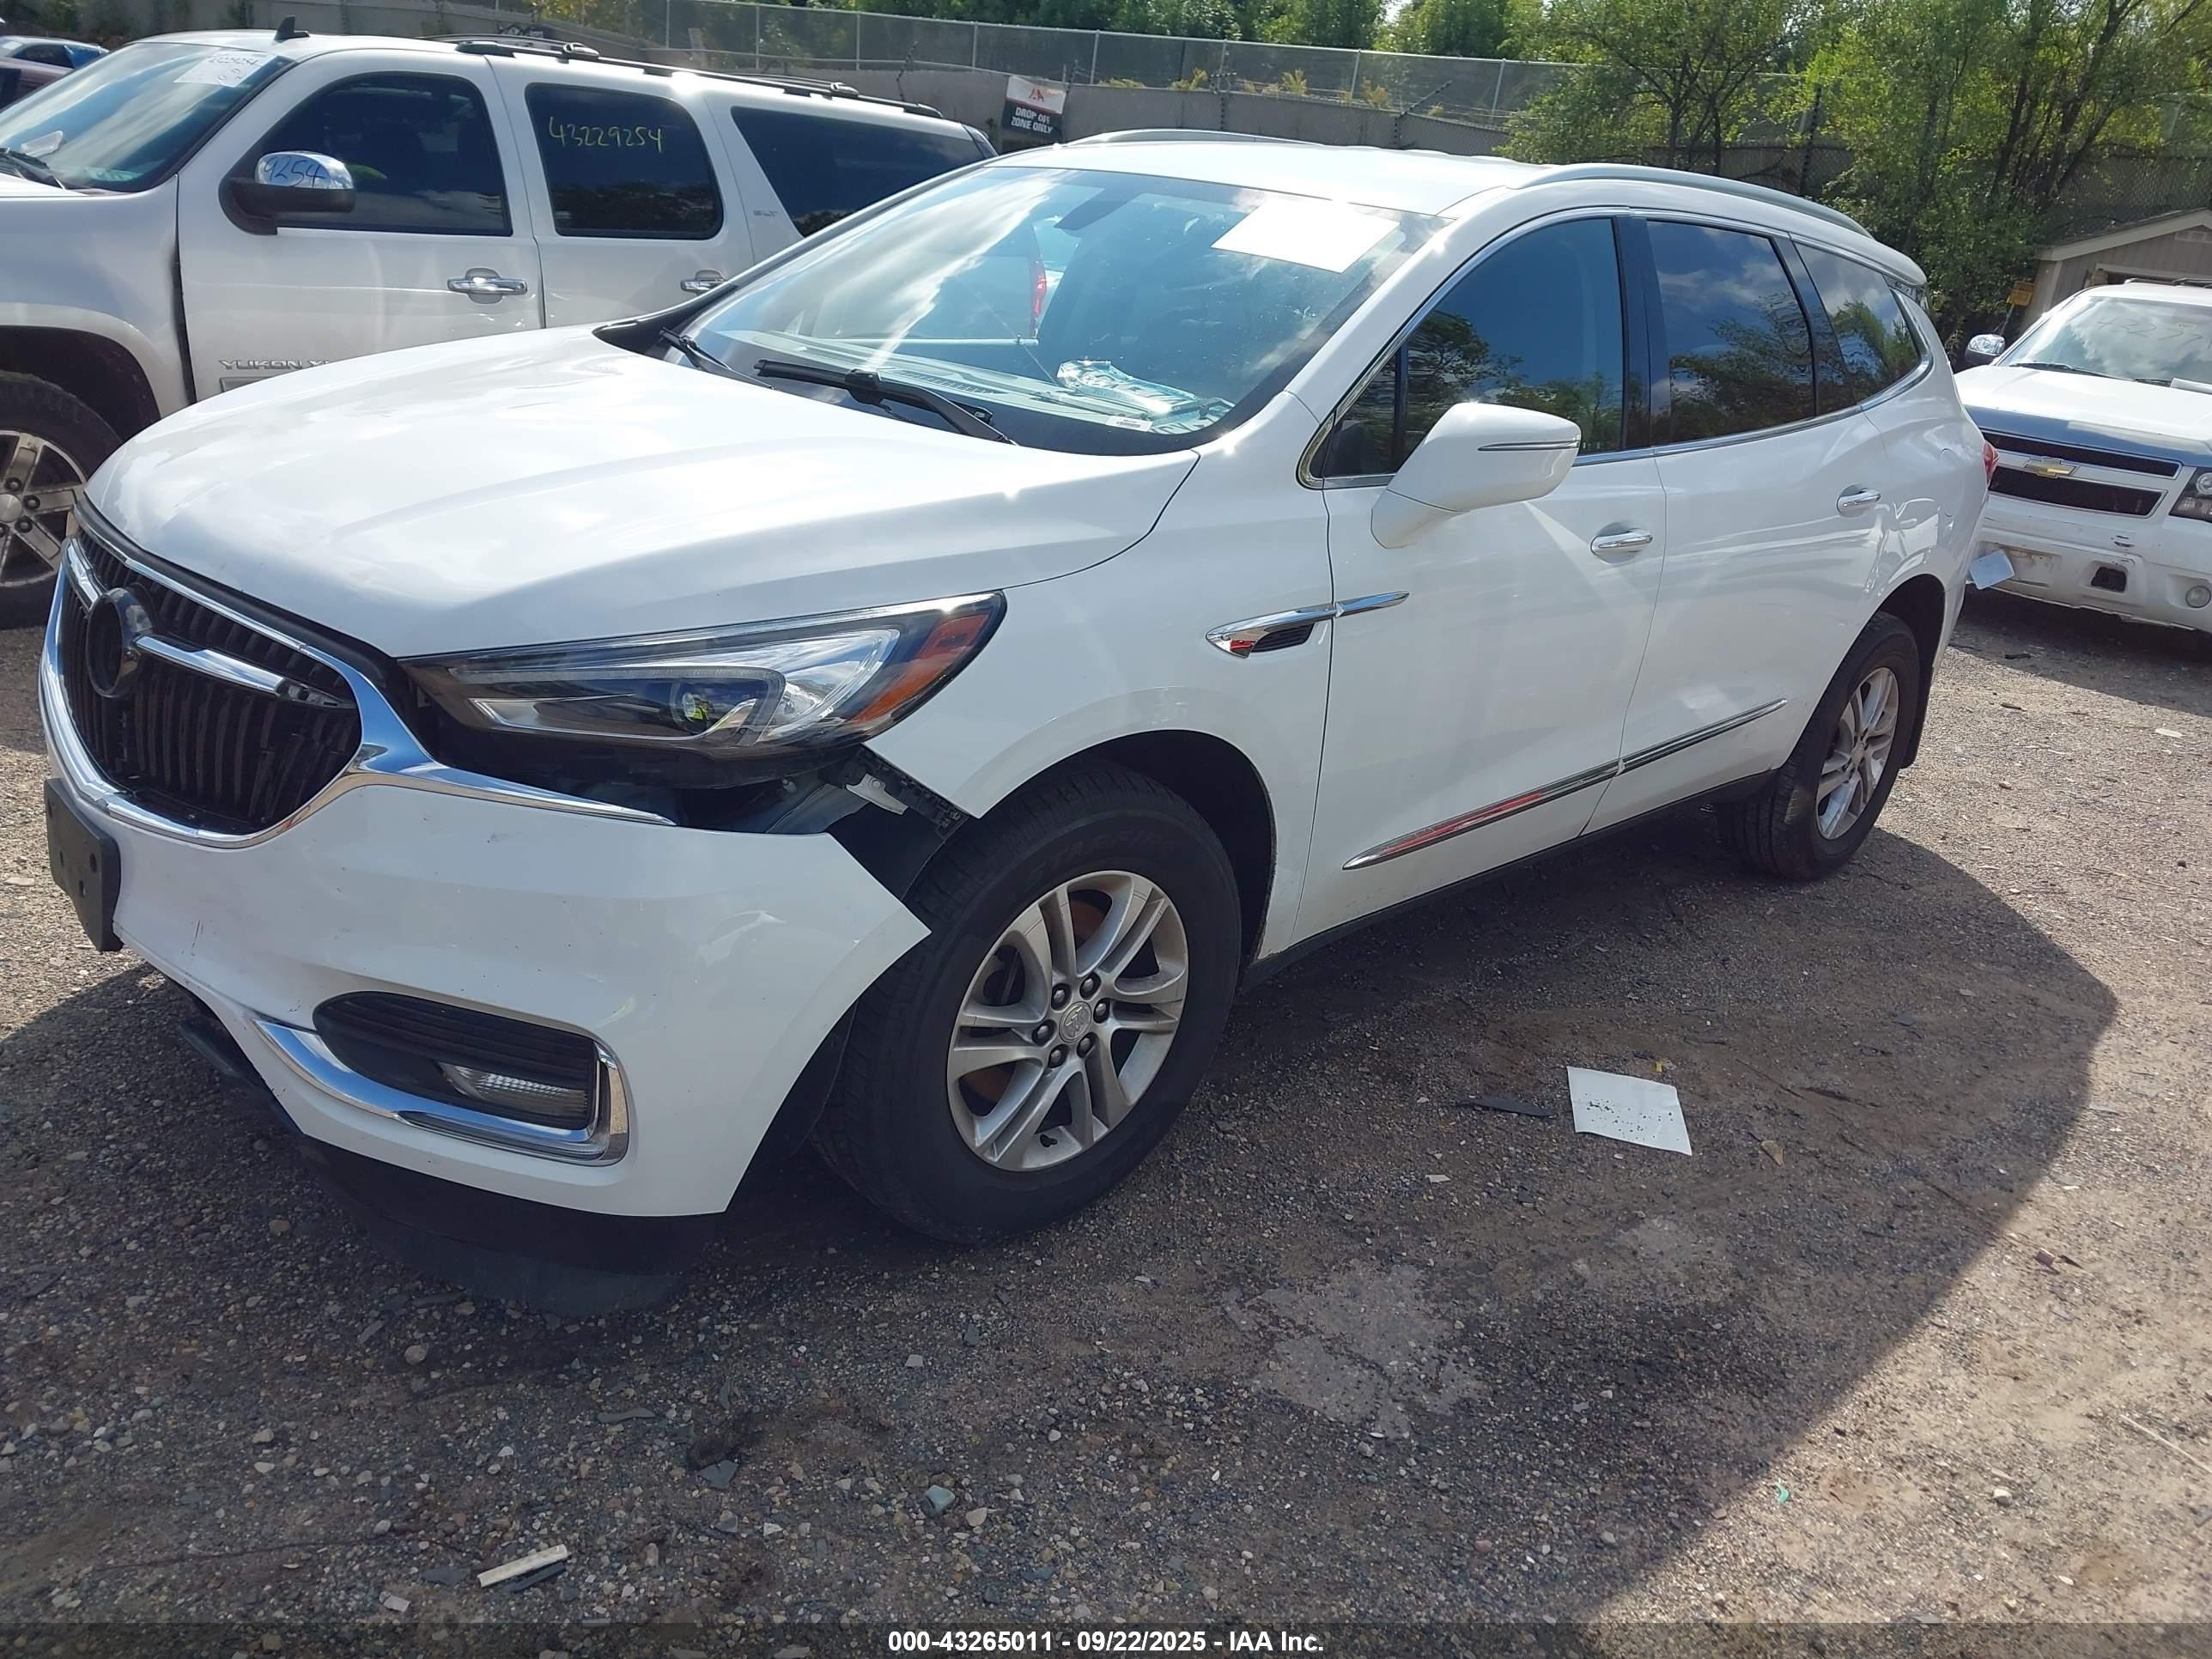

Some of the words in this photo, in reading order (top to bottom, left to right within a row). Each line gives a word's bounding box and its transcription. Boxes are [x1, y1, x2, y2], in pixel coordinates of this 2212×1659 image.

[1011, 116, 1033, 130] ZONE
[1032, 122, 1054, 134] ONLY
[1015, 106, 1037, 120] DROP
[1037, 113, 1051, 125] OFF
[549, 116, 663, 154] 43229254
[264, 155, 327, 187] 9254
[219, 359, 303, 370] YUKON
